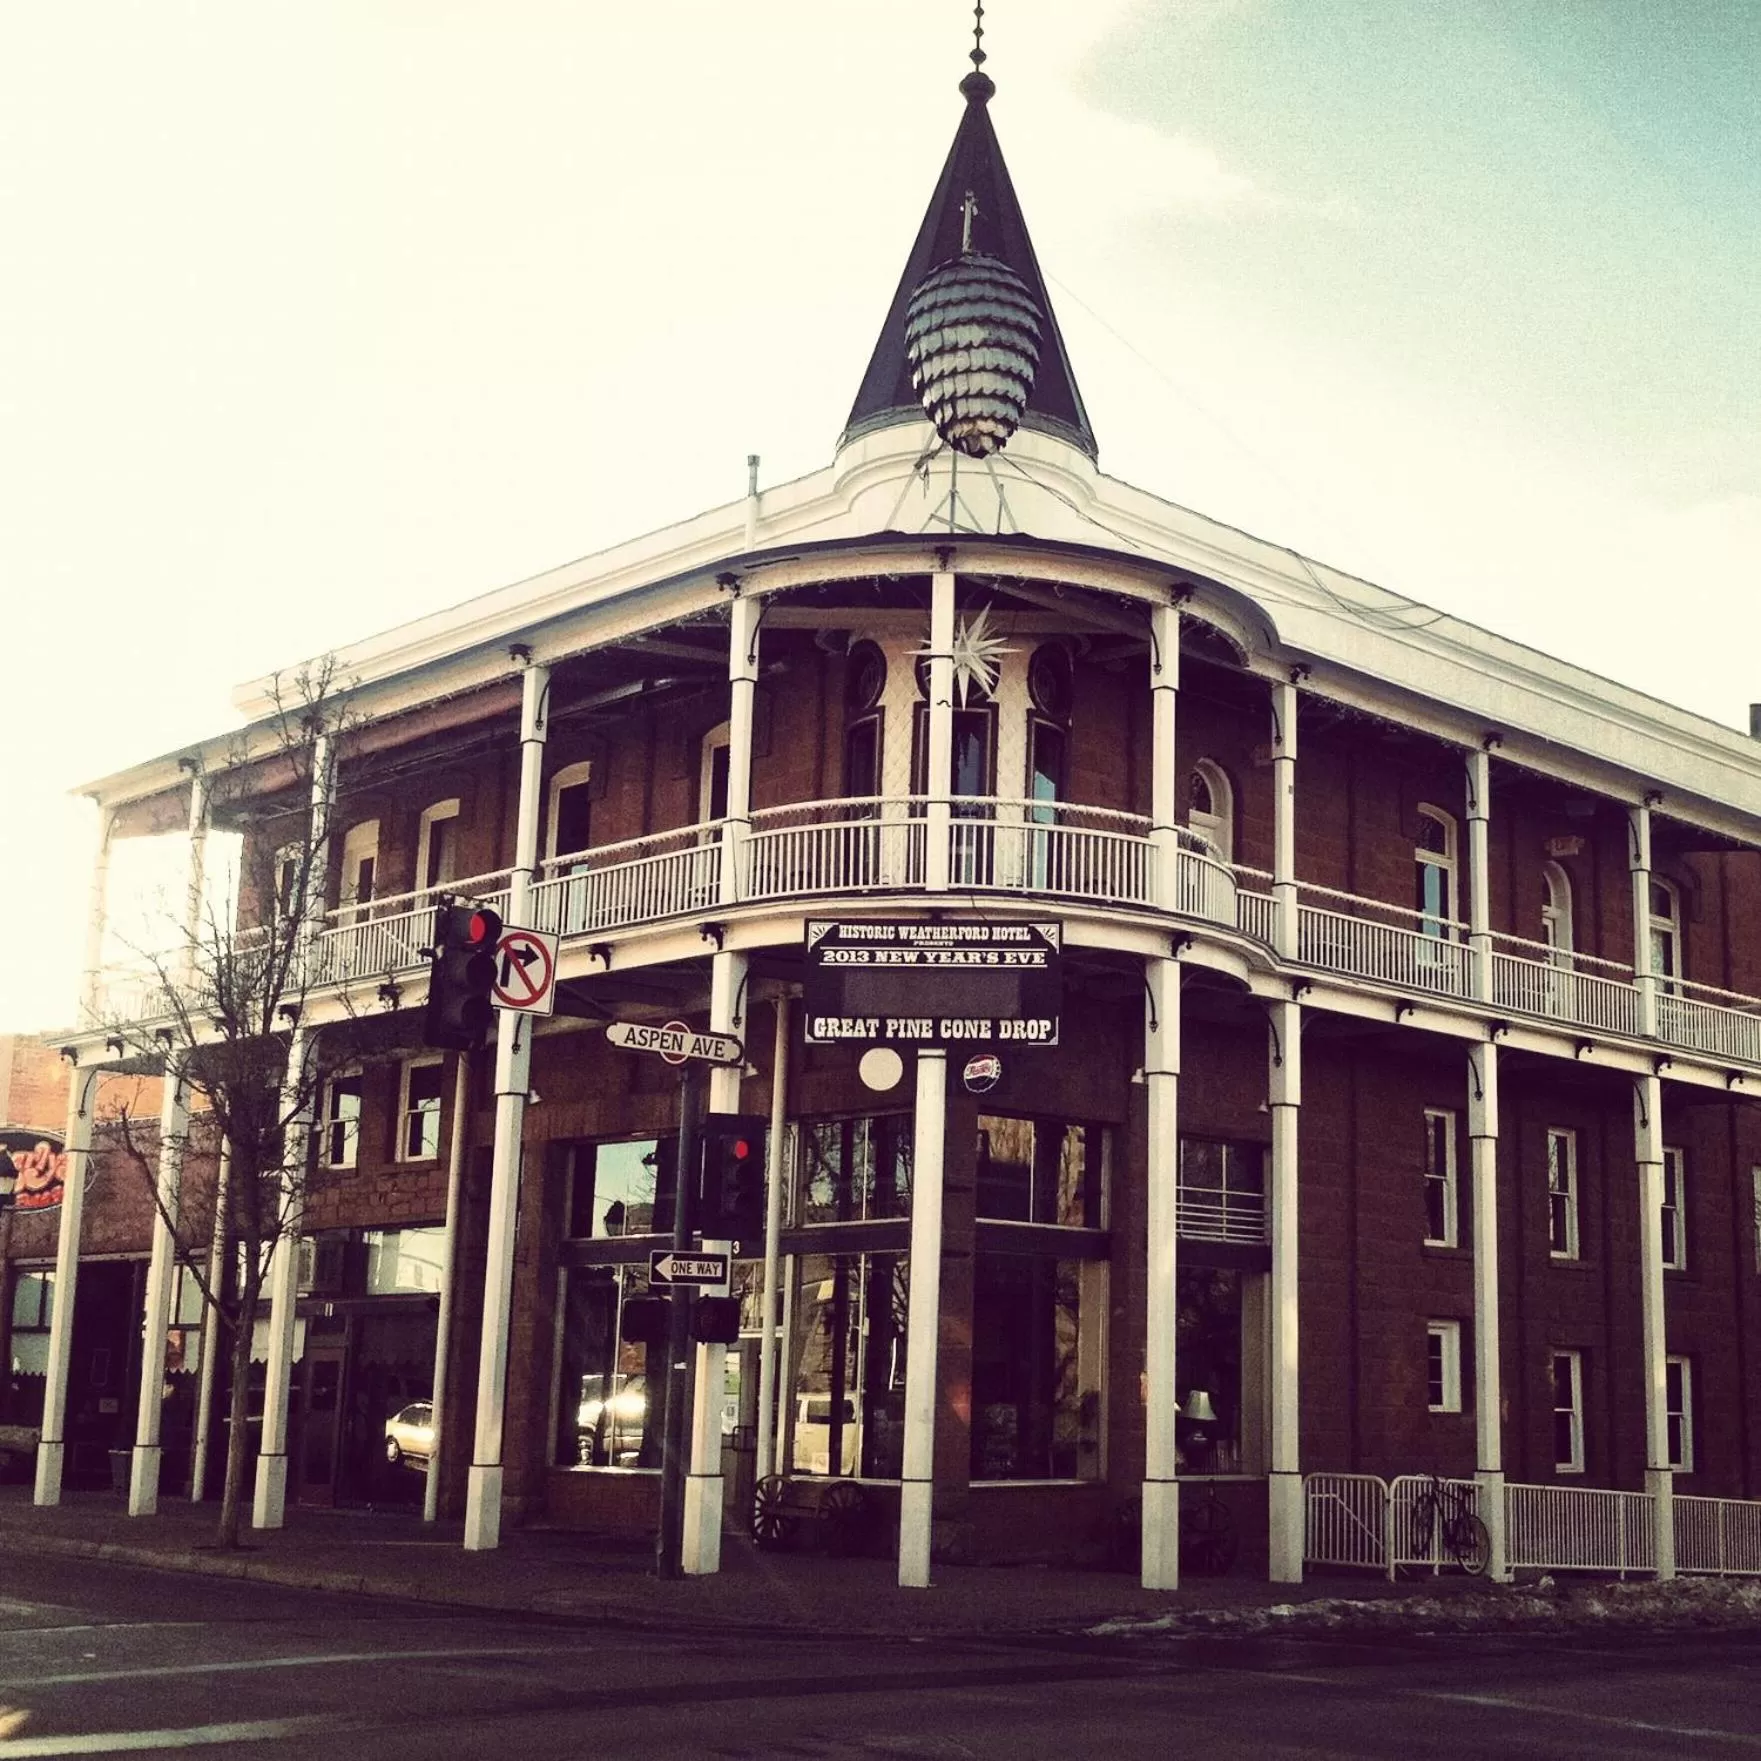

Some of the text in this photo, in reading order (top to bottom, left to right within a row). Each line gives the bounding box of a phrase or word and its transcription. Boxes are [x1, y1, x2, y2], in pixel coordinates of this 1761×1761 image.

[839, 924, 1031, 941] HISTORIC WEATHERFORD HOTEL
[823, 950, 1046, 964] 2013 NEW YEAR'S EVE
[813, 1017, 1052, 1040] GREAT PINE CONE DROP
[623, 1027, 726, 1058] ASPEN AVE
[671, 1261, 720, 1276] ONE WAY
